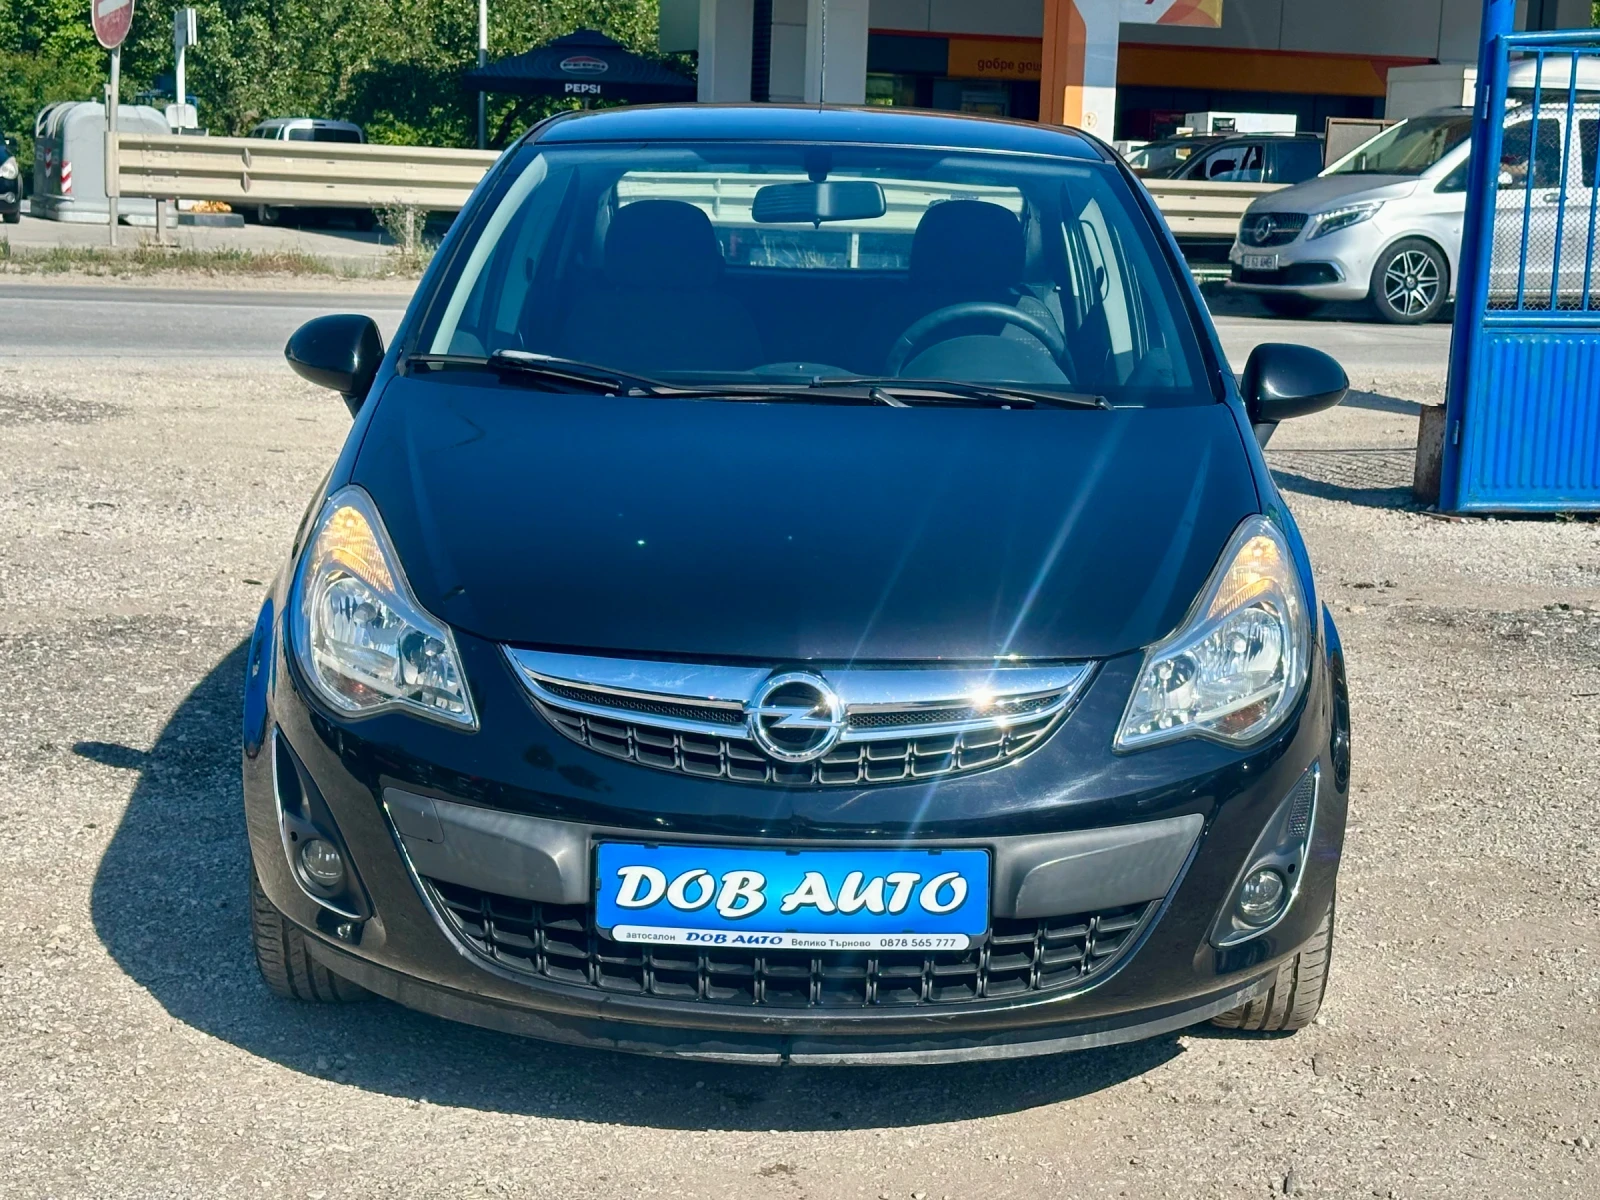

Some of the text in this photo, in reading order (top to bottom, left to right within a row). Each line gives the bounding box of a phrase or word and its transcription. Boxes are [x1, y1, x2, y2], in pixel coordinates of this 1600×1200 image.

[564, 83, 601, 93] PEPSI
[615, 865, 968, 918] DOB AUTO
[626, 932, 957, 949] автосалон DOB AUTO Велико Търново 0878 565 777
